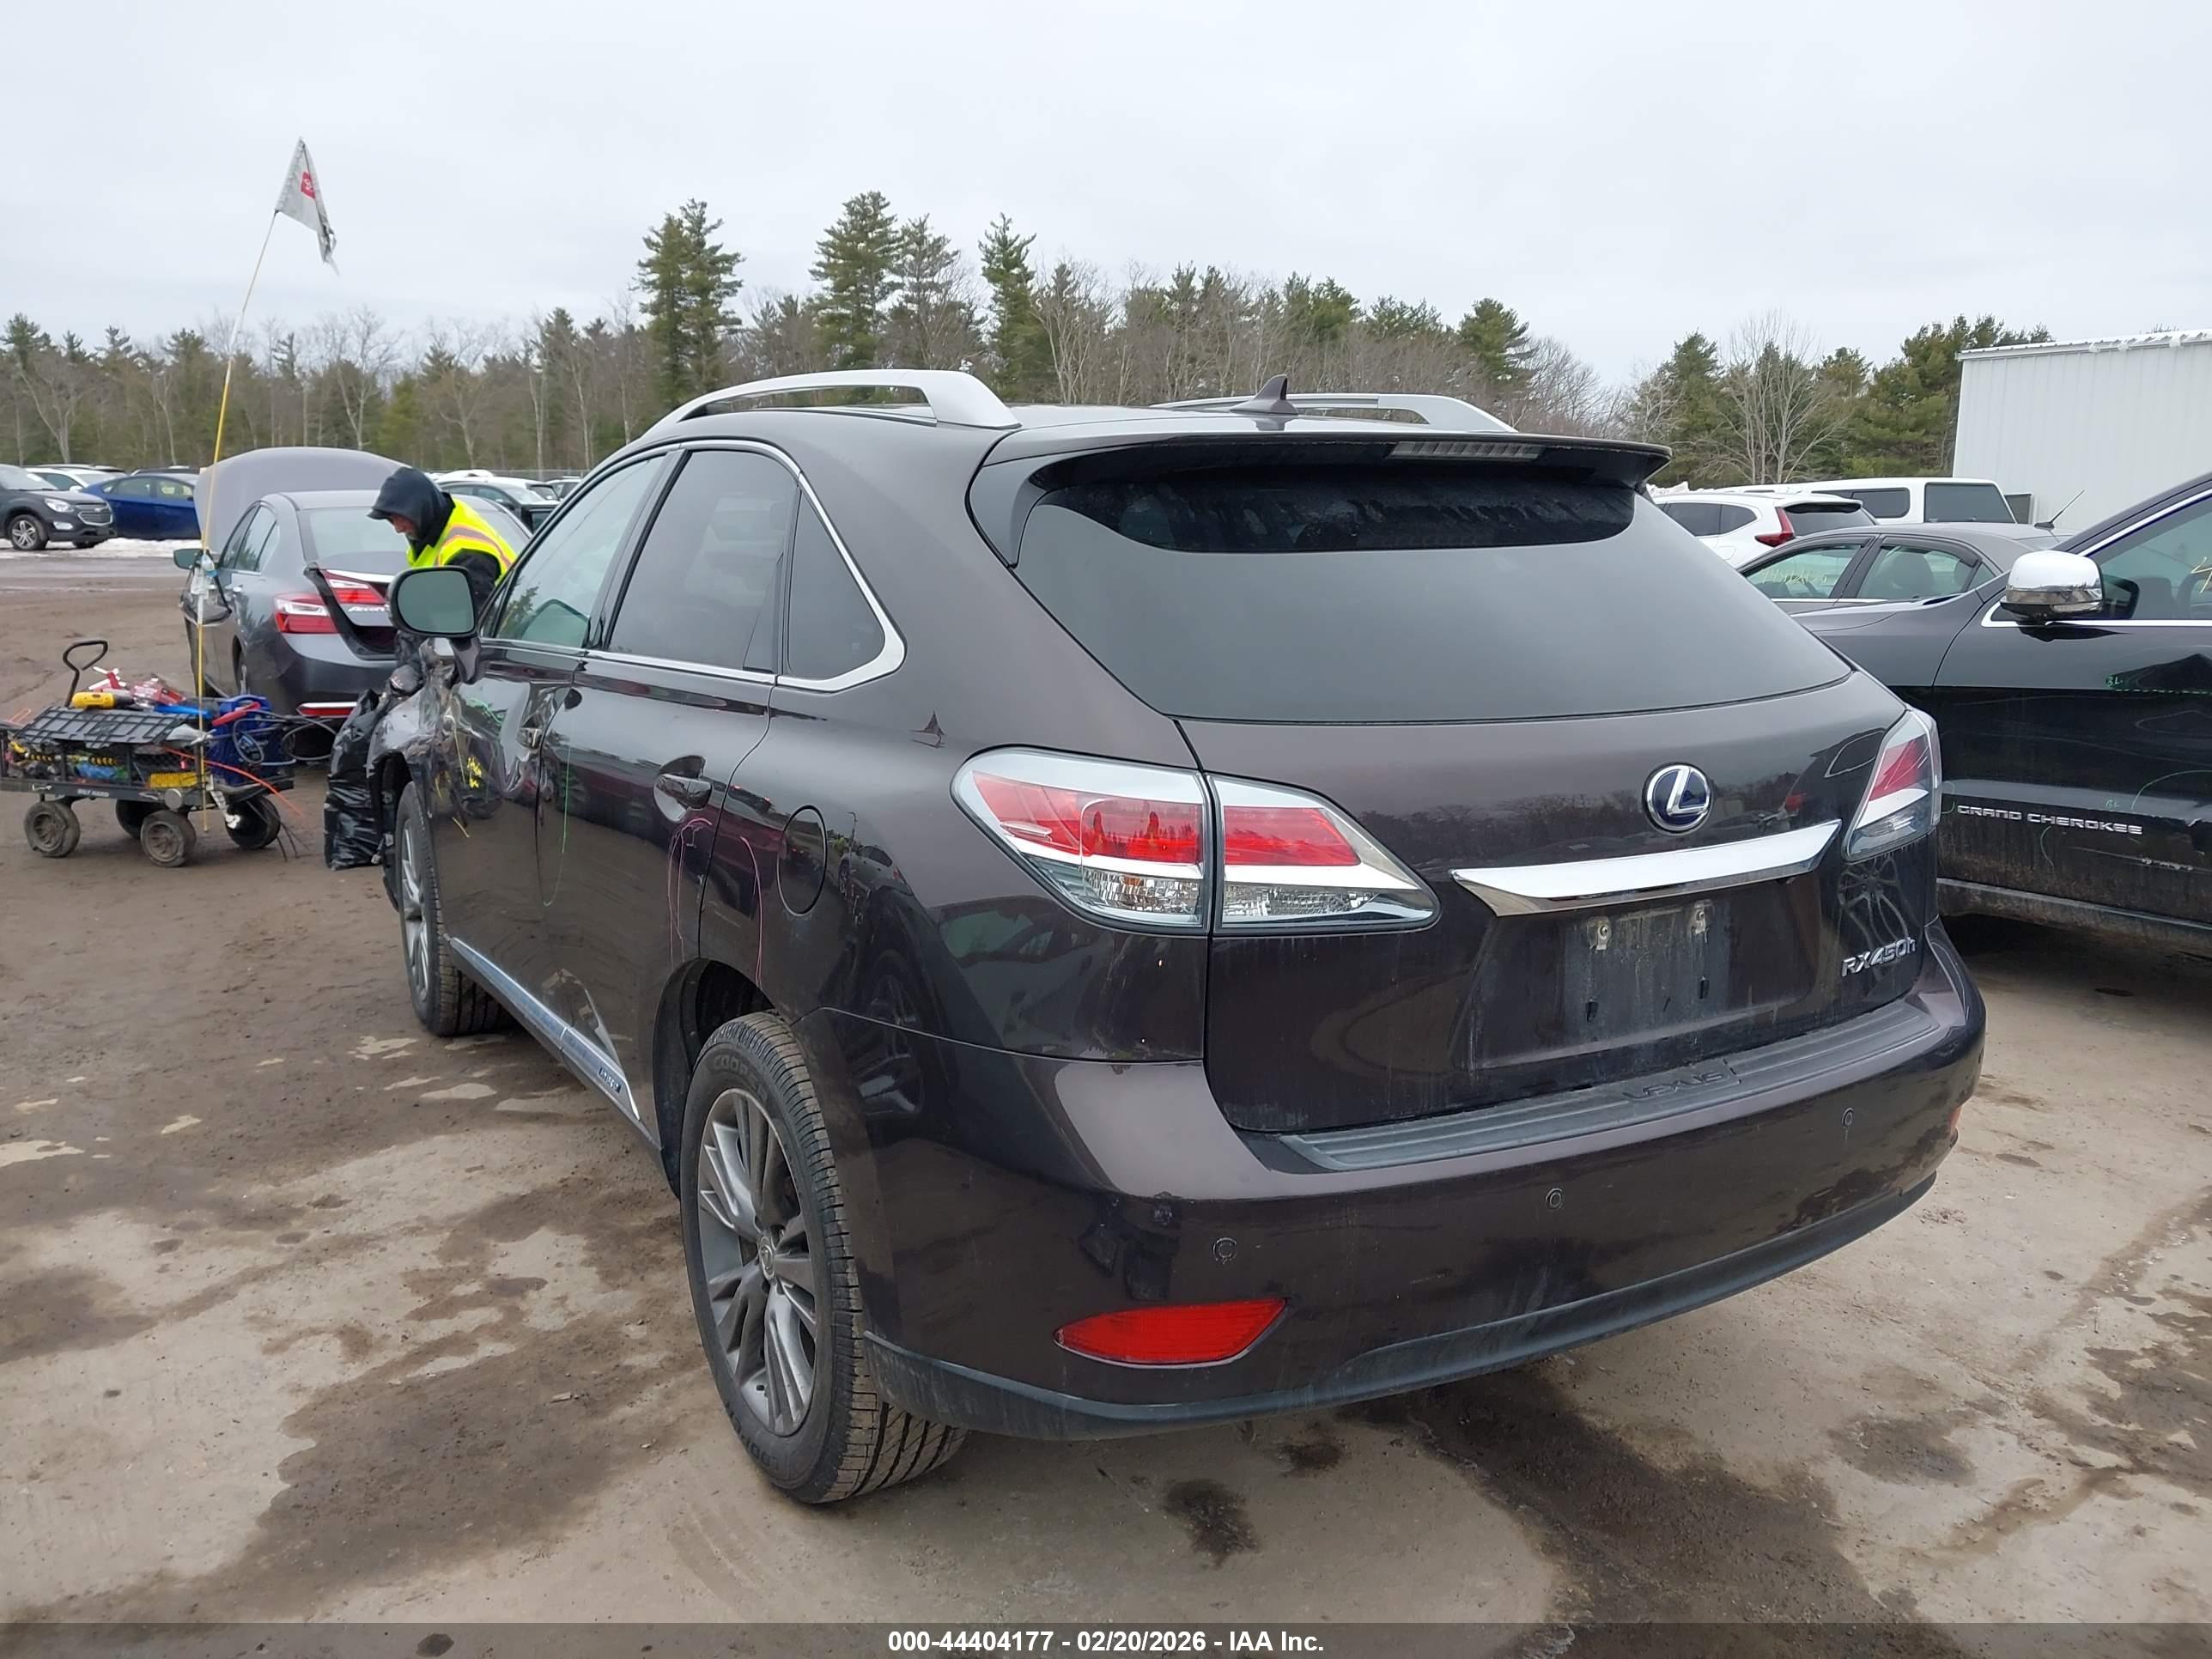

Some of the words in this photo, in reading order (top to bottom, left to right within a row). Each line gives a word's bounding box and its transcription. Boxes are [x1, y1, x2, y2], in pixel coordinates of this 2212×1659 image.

[1957, 805, 2021, 821] GRAND
[2027, 813, 2143, 836] CHEROKEE
[1841, 936, 1917, 977] RX450h
